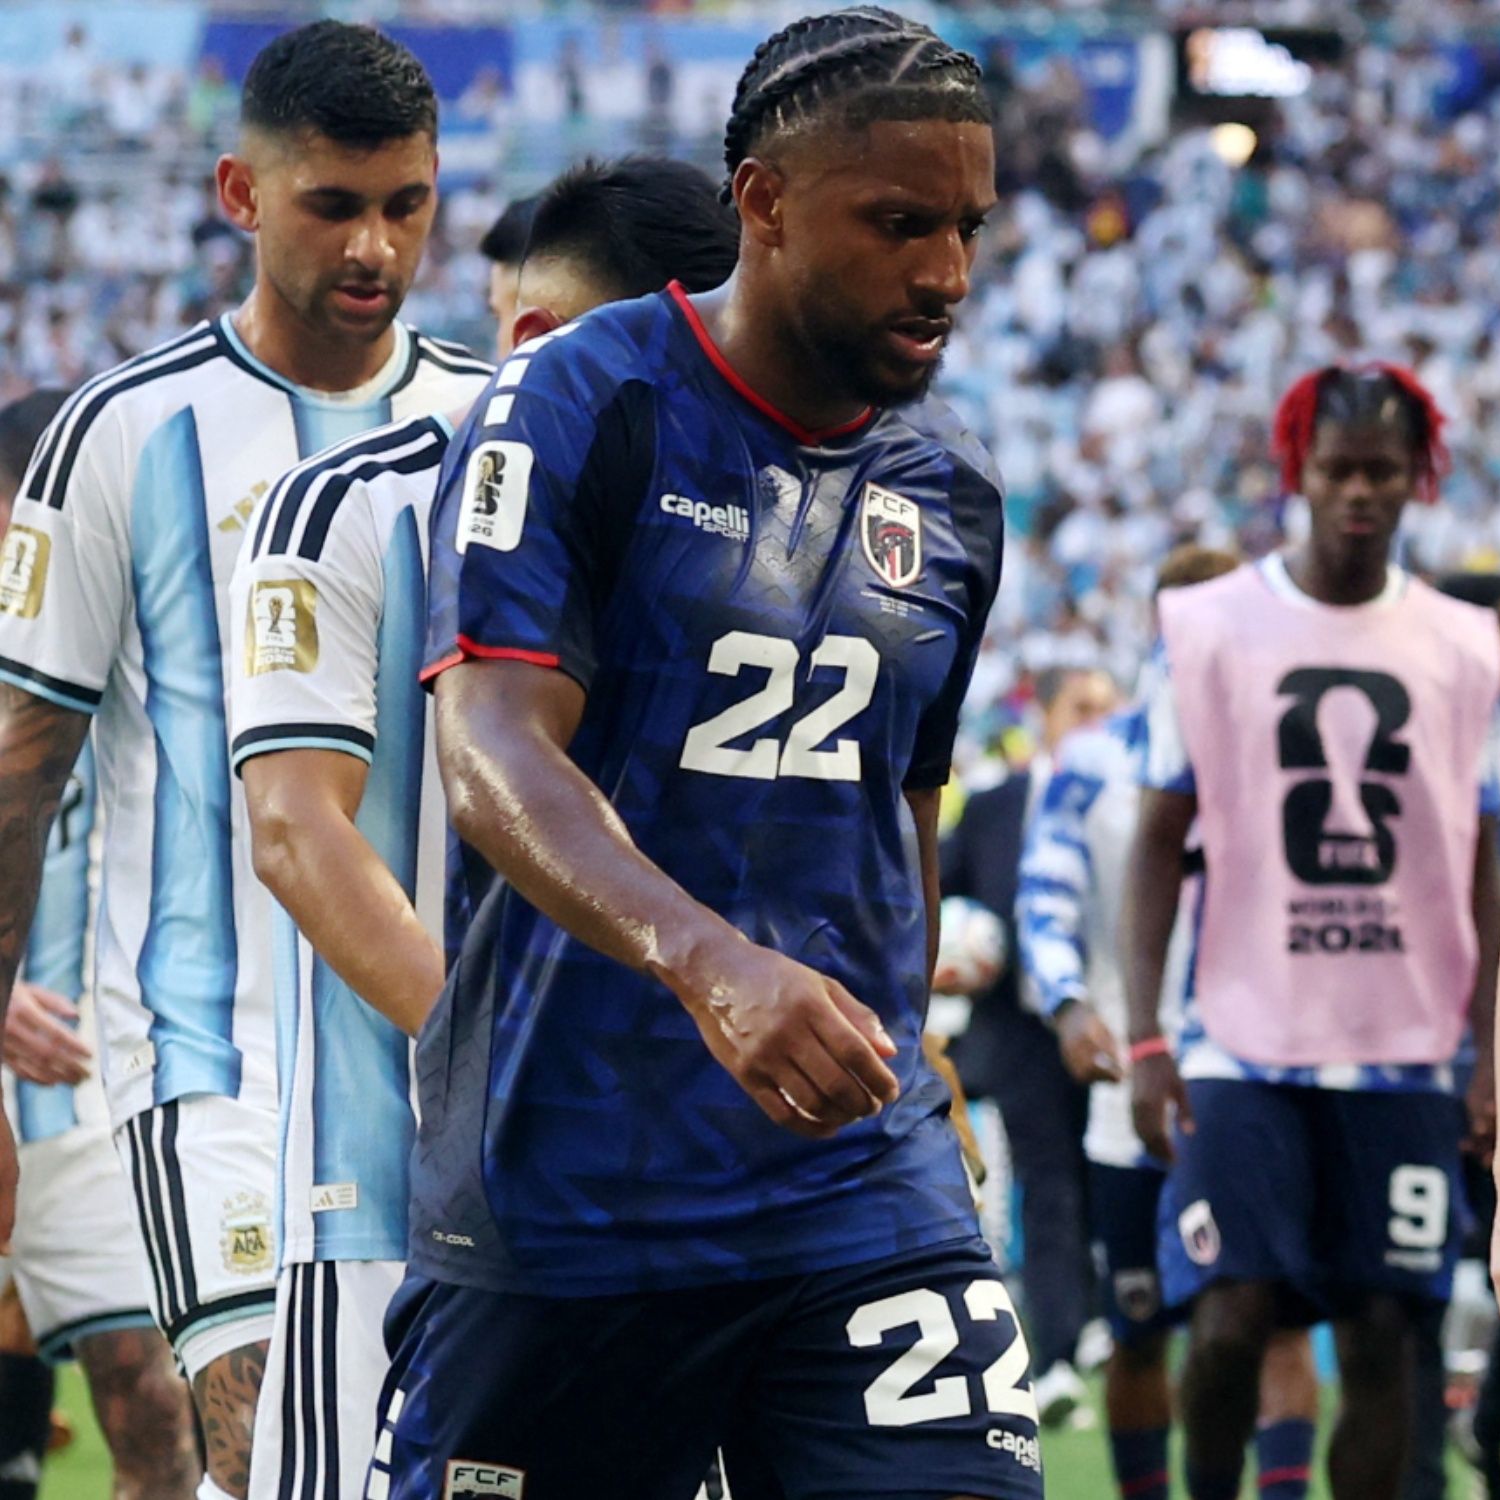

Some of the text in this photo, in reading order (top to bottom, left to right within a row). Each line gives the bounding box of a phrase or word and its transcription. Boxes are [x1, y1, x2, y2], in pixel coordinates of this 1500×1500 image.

[660, 493, 749, 534] capelli
[869, 489, 915, 515] FCF
[702, 523, 749, 542] SPORT
[679, 630, 881, 782] 22
[1387, 1163, 1449, 1249] 9
[845, 1279, 1040, 1427] 22
[454, 1466, 518, 1487] FCF
